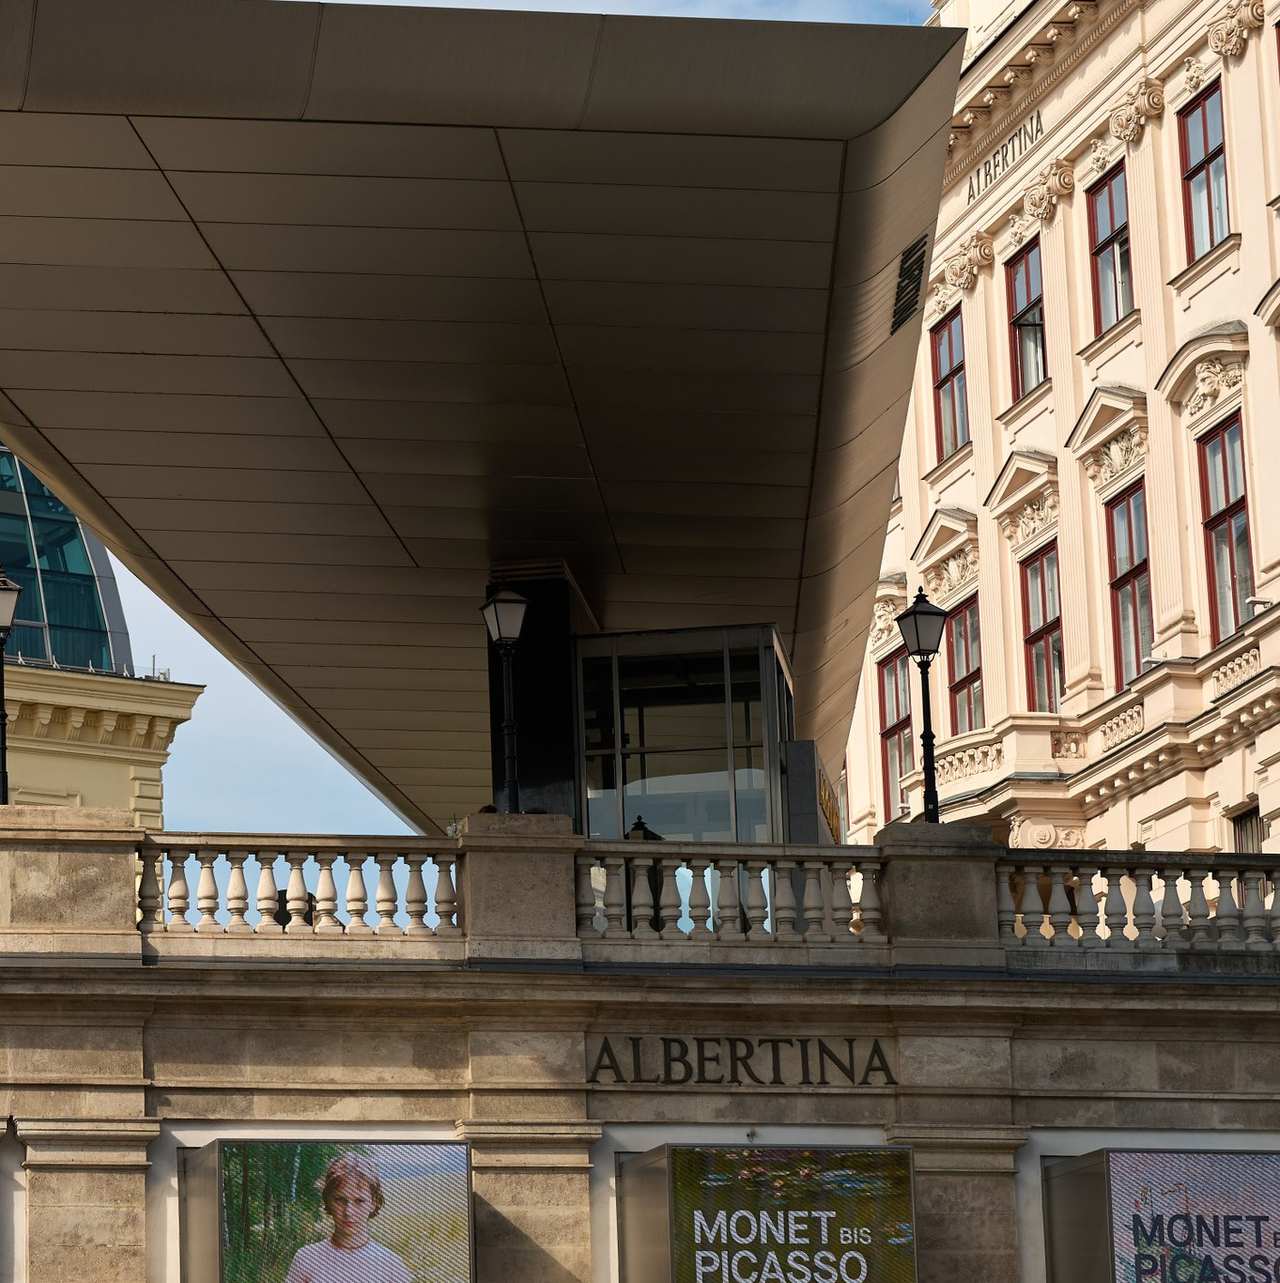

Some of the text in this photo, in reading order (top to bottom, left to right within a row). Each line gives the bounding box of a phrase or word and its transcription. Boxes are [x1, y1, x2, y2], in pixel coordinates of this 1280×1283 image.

[966, 109, 1044, 206] ALBERTINA
[587, 1036, 898, 1086] ALBERTINA
[693, 1209, 872, 1245] MONET BIS
[1132, 1213, 1270, 1248] MONET
